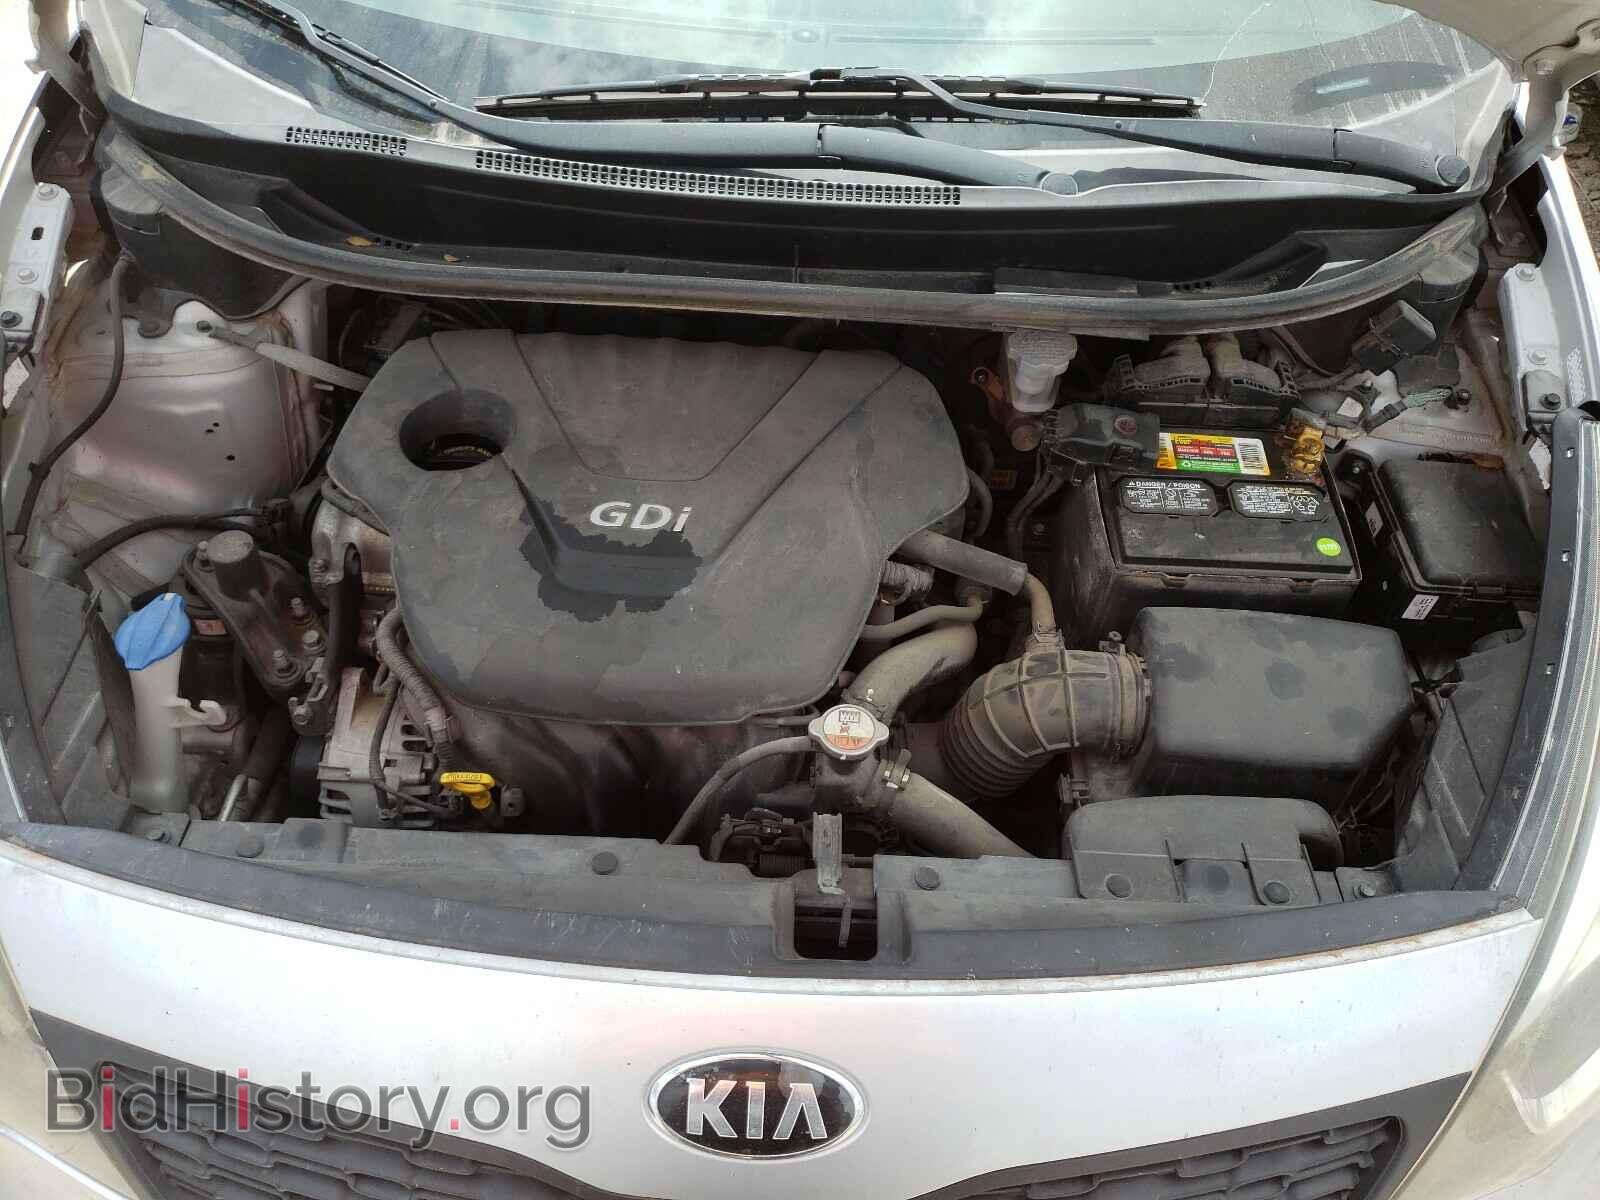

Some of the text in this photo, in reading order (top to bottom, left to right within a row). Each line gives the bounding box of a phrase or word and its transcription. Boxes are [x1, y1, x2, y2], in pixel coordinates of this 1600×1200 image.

[1136, 481, 1166, 489] DANGER
[590, 501, 692, 532] GDi
[686, 1077, 828, 1139] KIA
